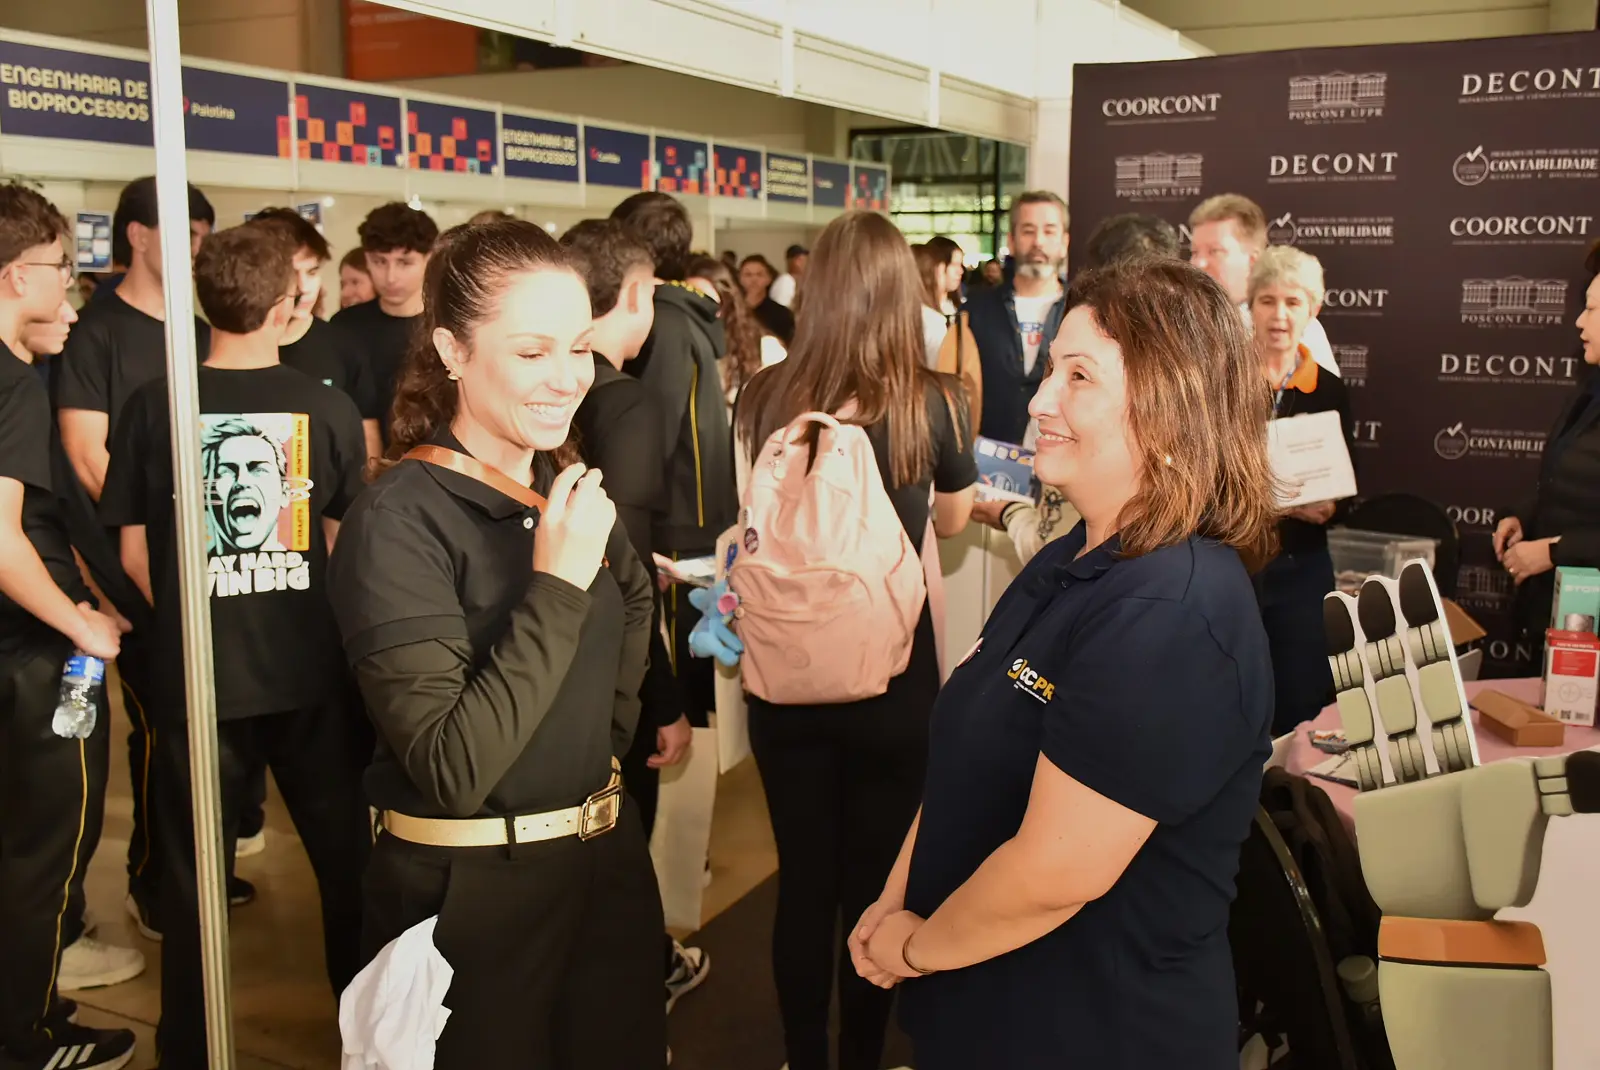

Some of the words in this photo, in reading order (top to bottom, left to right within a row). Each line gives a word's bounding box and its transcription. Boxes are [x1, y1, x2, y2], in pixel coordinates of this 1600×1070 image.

[1, 64, 122, 97] ENGENHARIA
[124, 78, 148, 99] DE
[1462, 67, 1600, 95] DECONT
[8, 88, 149, 121] BIOPROCESSOS
[191, 102, 236, 120] Palotina
[1102, 93, 1221, 117] COORCONT
[1289, 109, 1345, 120] POSCONT
[1350, 107, 1383, 118] UFPR
[1269, 152, 1399, 176] DECONT
[1490, 157, 1598, 172] CONTABILIDADE
[1297, 225, 1393, 238] CONTABILIDADE
[1449, 215, 1593, 236] COORCONT
[1461, 314, 1522, 324] POSCONT
[1528, 314, 1562, 325] UFPR
[1440, 353, 1579, 378] DECONT
[253, 566, 310, 593] BIG
